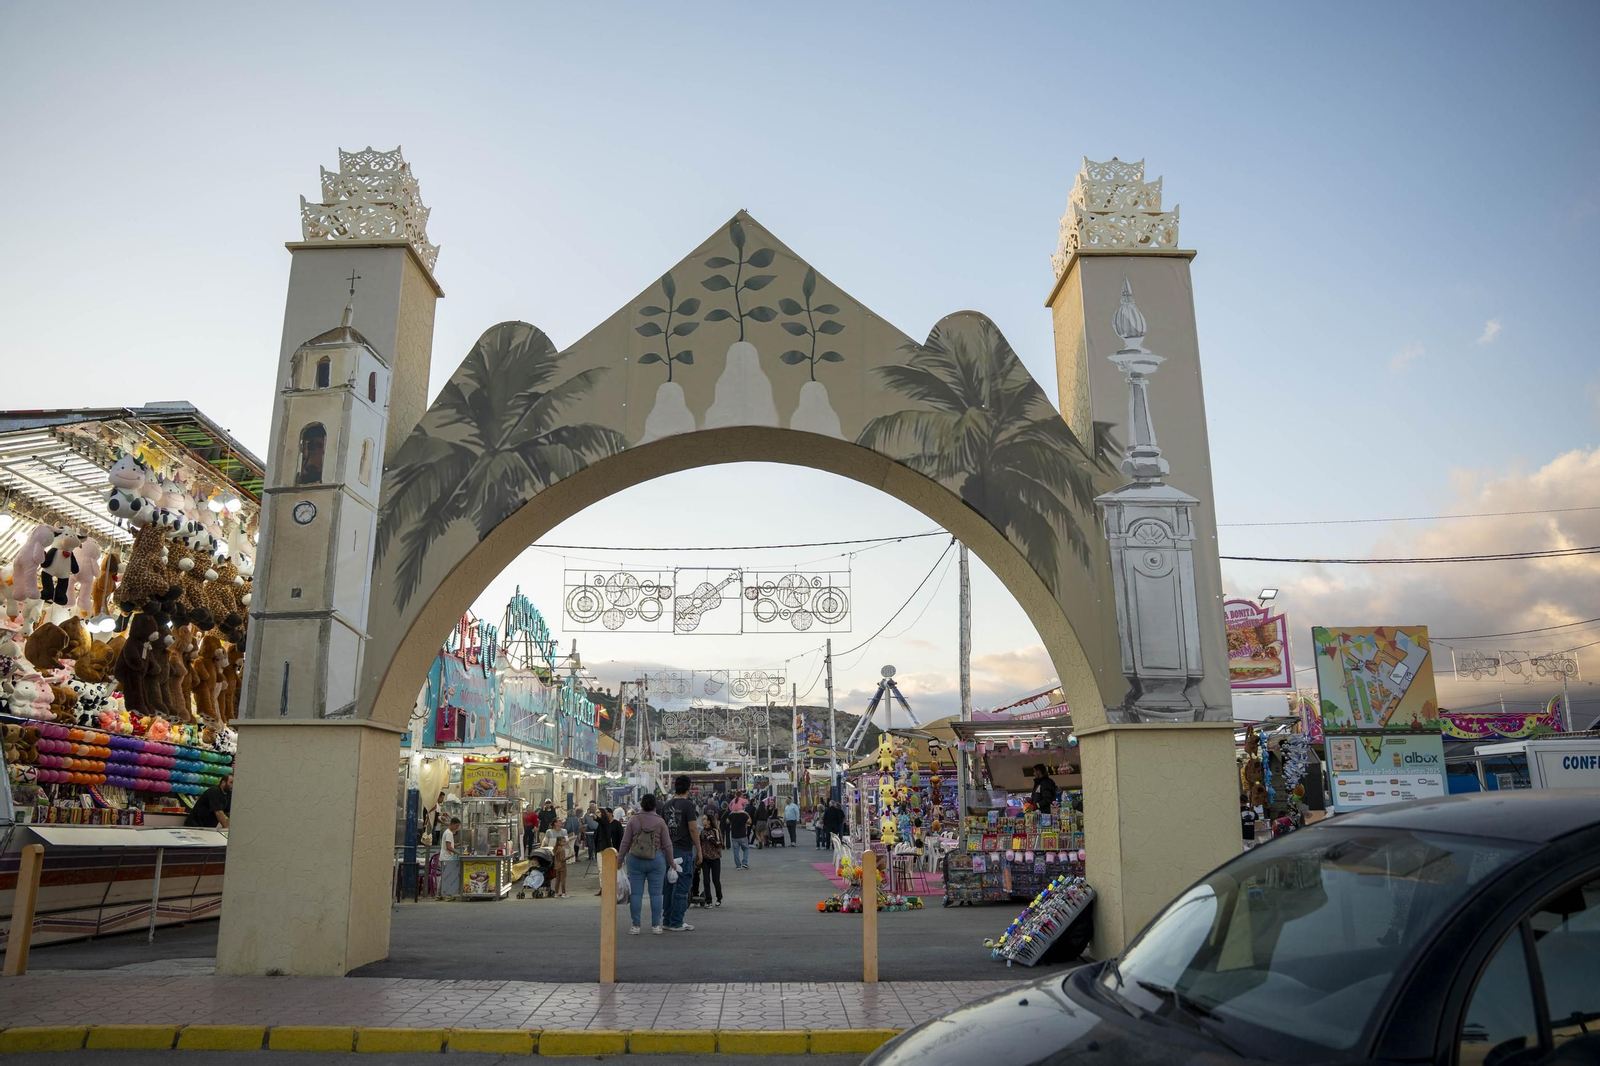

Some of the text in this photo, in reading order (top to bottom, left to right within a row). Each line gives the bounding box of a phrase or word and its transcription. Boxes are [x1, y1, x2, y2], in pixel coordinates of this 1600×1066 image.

[1230, 608, 1255, 619] BONITA
[1405, 752, 1438, 763] albox
[467, 769, 504, 779] BUÑUELOS
[465, 864, 494, 873] BUÑUELOS
